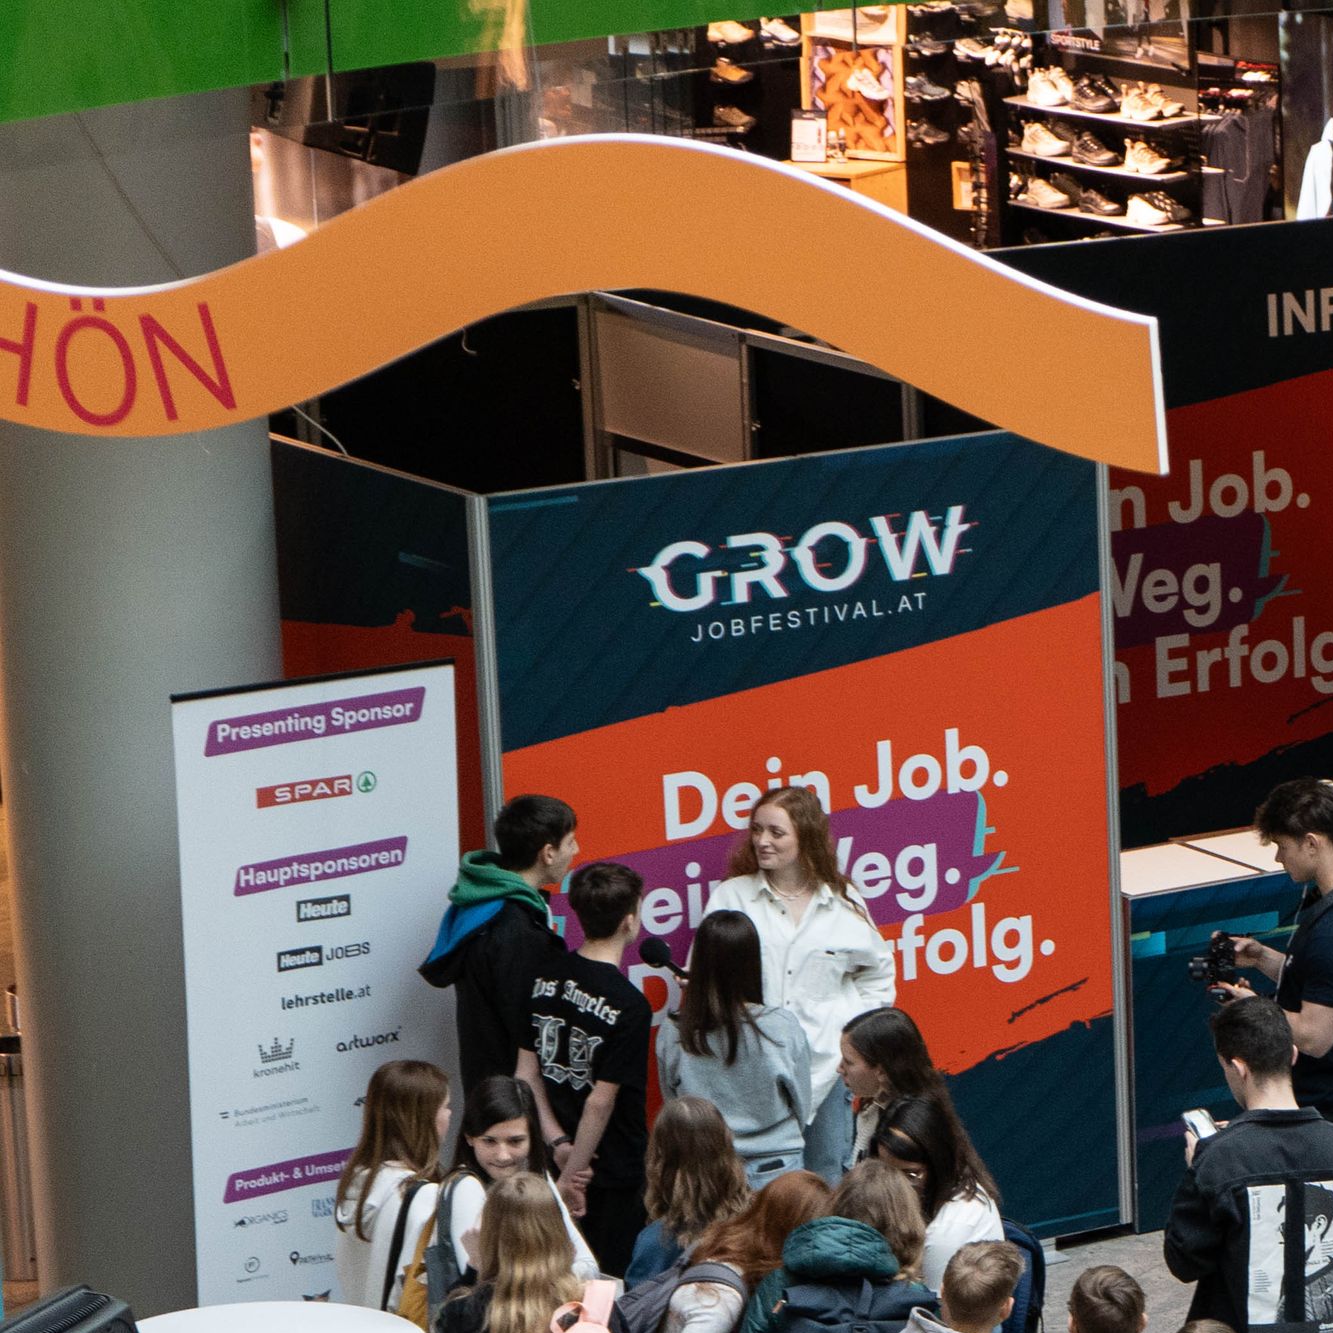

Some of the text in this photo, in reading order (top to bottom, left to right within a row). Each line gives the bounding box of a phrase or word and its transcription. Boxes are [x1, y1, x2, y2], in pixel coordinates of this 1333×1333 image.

[1168, 450, 1311, 524] Job.
[636, 504, 975, 612] GROW
[691, 592, 927, 642] JOBFESTIVAL.AT
[217, 702, 414, 743] Presenting Sponsor
[854, 728, 1009, 808] Job.
[274, 778, 351, 802] SPAR
[239, 849, 403, 887] Hauptsponsoren
[299, 899, 349, 920] Heute
[280, 942, 371, 968] Heute JOBS
[281, 985, 371, 1010] lehrstelle.at
[336, 1030, 400, 1053] artworx
[253, 1061, 301, 1078] kronehit
[235, 1161, 346, 1191] Produkt- & Umset
